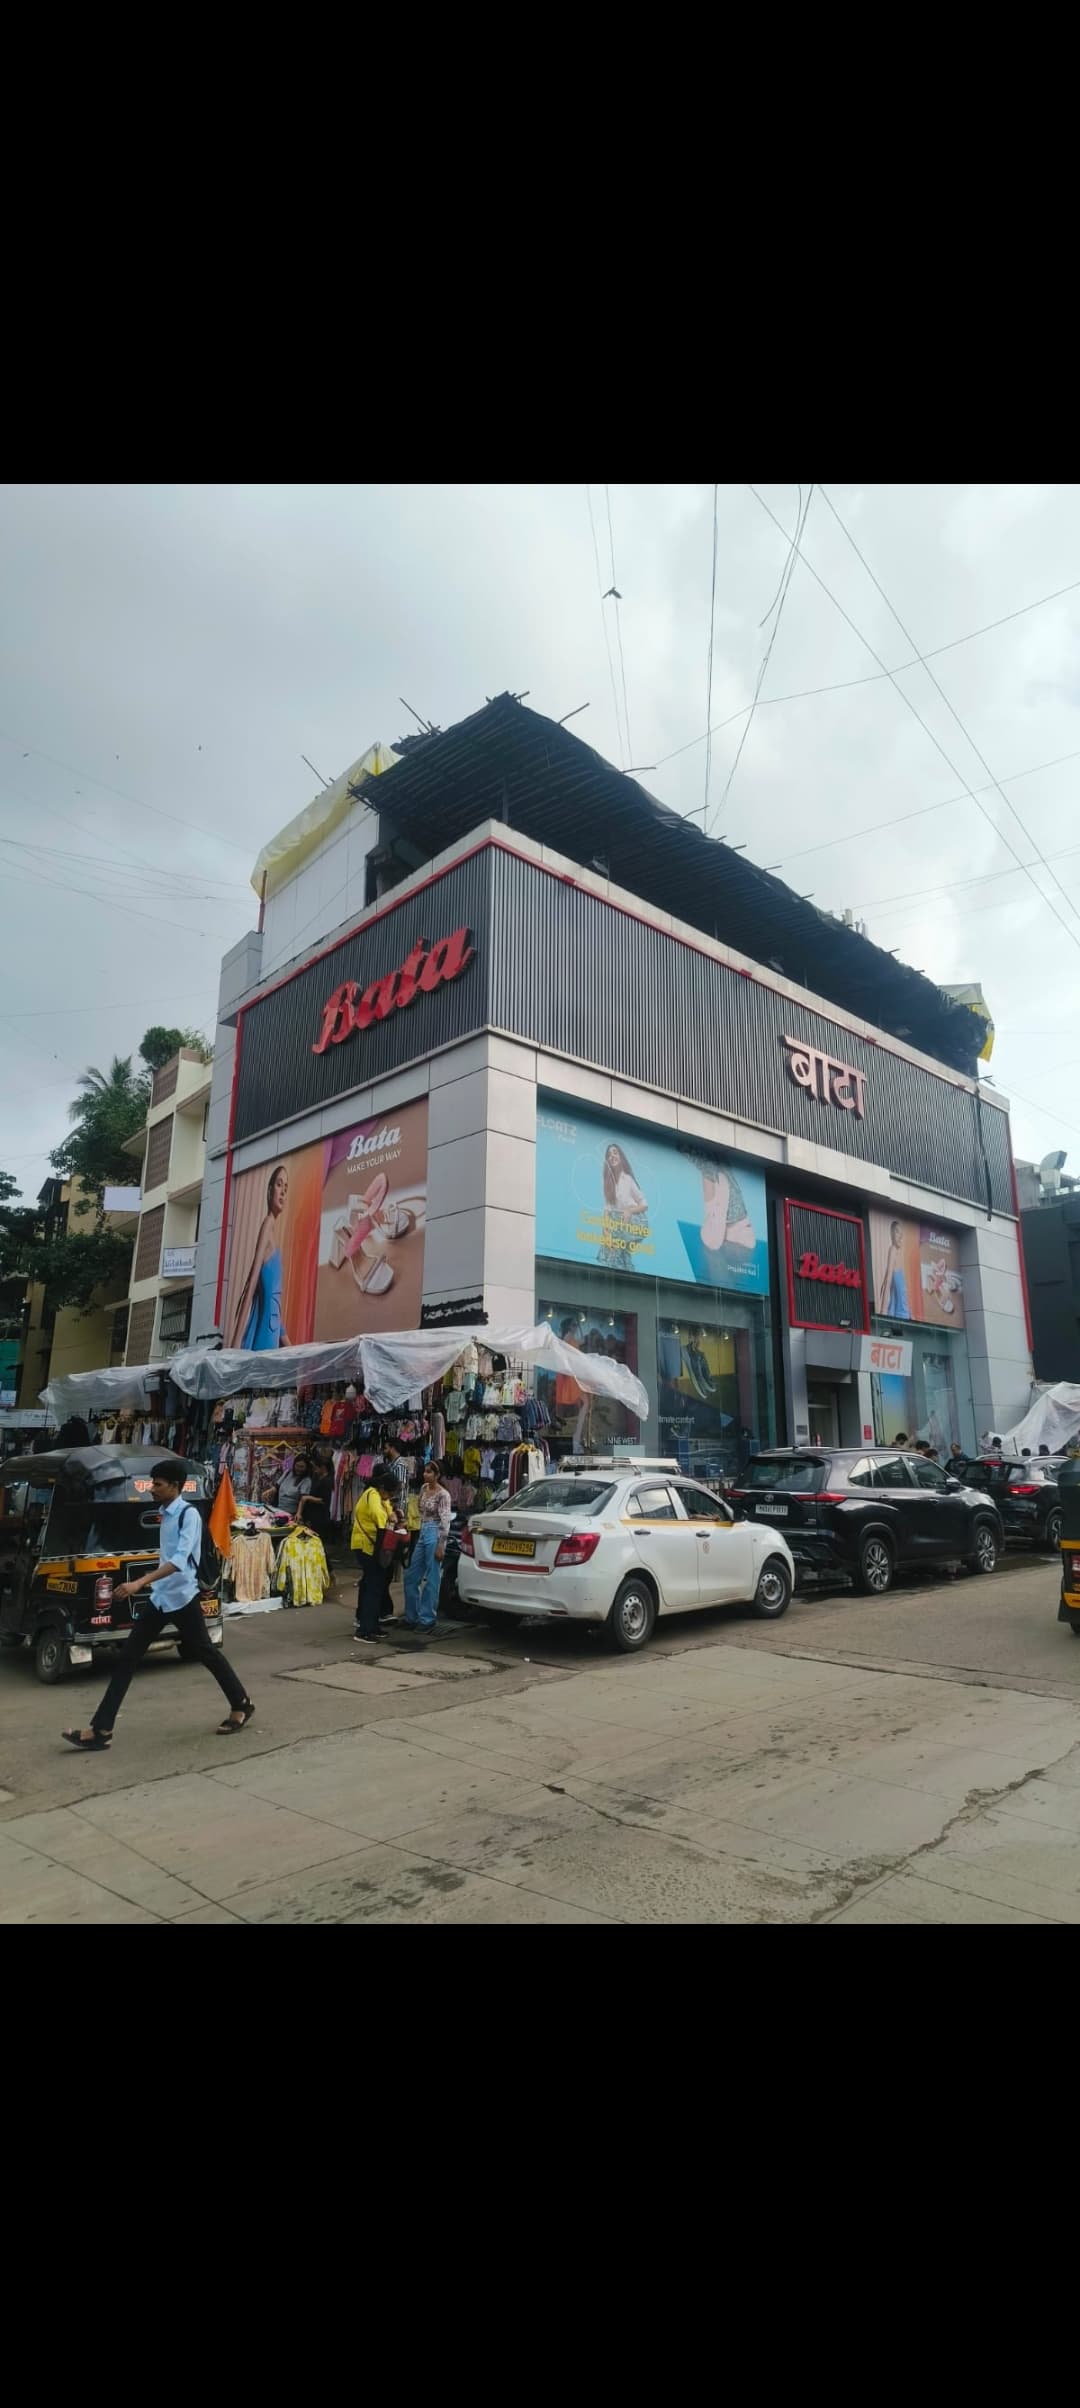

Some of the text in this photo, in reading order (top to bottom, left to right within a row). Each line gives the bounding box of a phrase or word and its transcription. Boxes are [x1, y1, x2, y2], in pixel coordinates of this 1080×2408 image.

[312, 925, 477, 1055] Bata
[782, 1034, 868, 1119] बाटा
[346, 1125, 401, 1161] Bata
[347, 1149, 401, 1174] MAKE YOUR WAY
[613, 1238, 626, 1250] so
[928, 1231, 951, 1248] Bata
[796, 1252, 861, 1288] Bata
[870, 1341, 903, 1370] बाटा
[607, 1436, 637, 1445] NINE WEST
